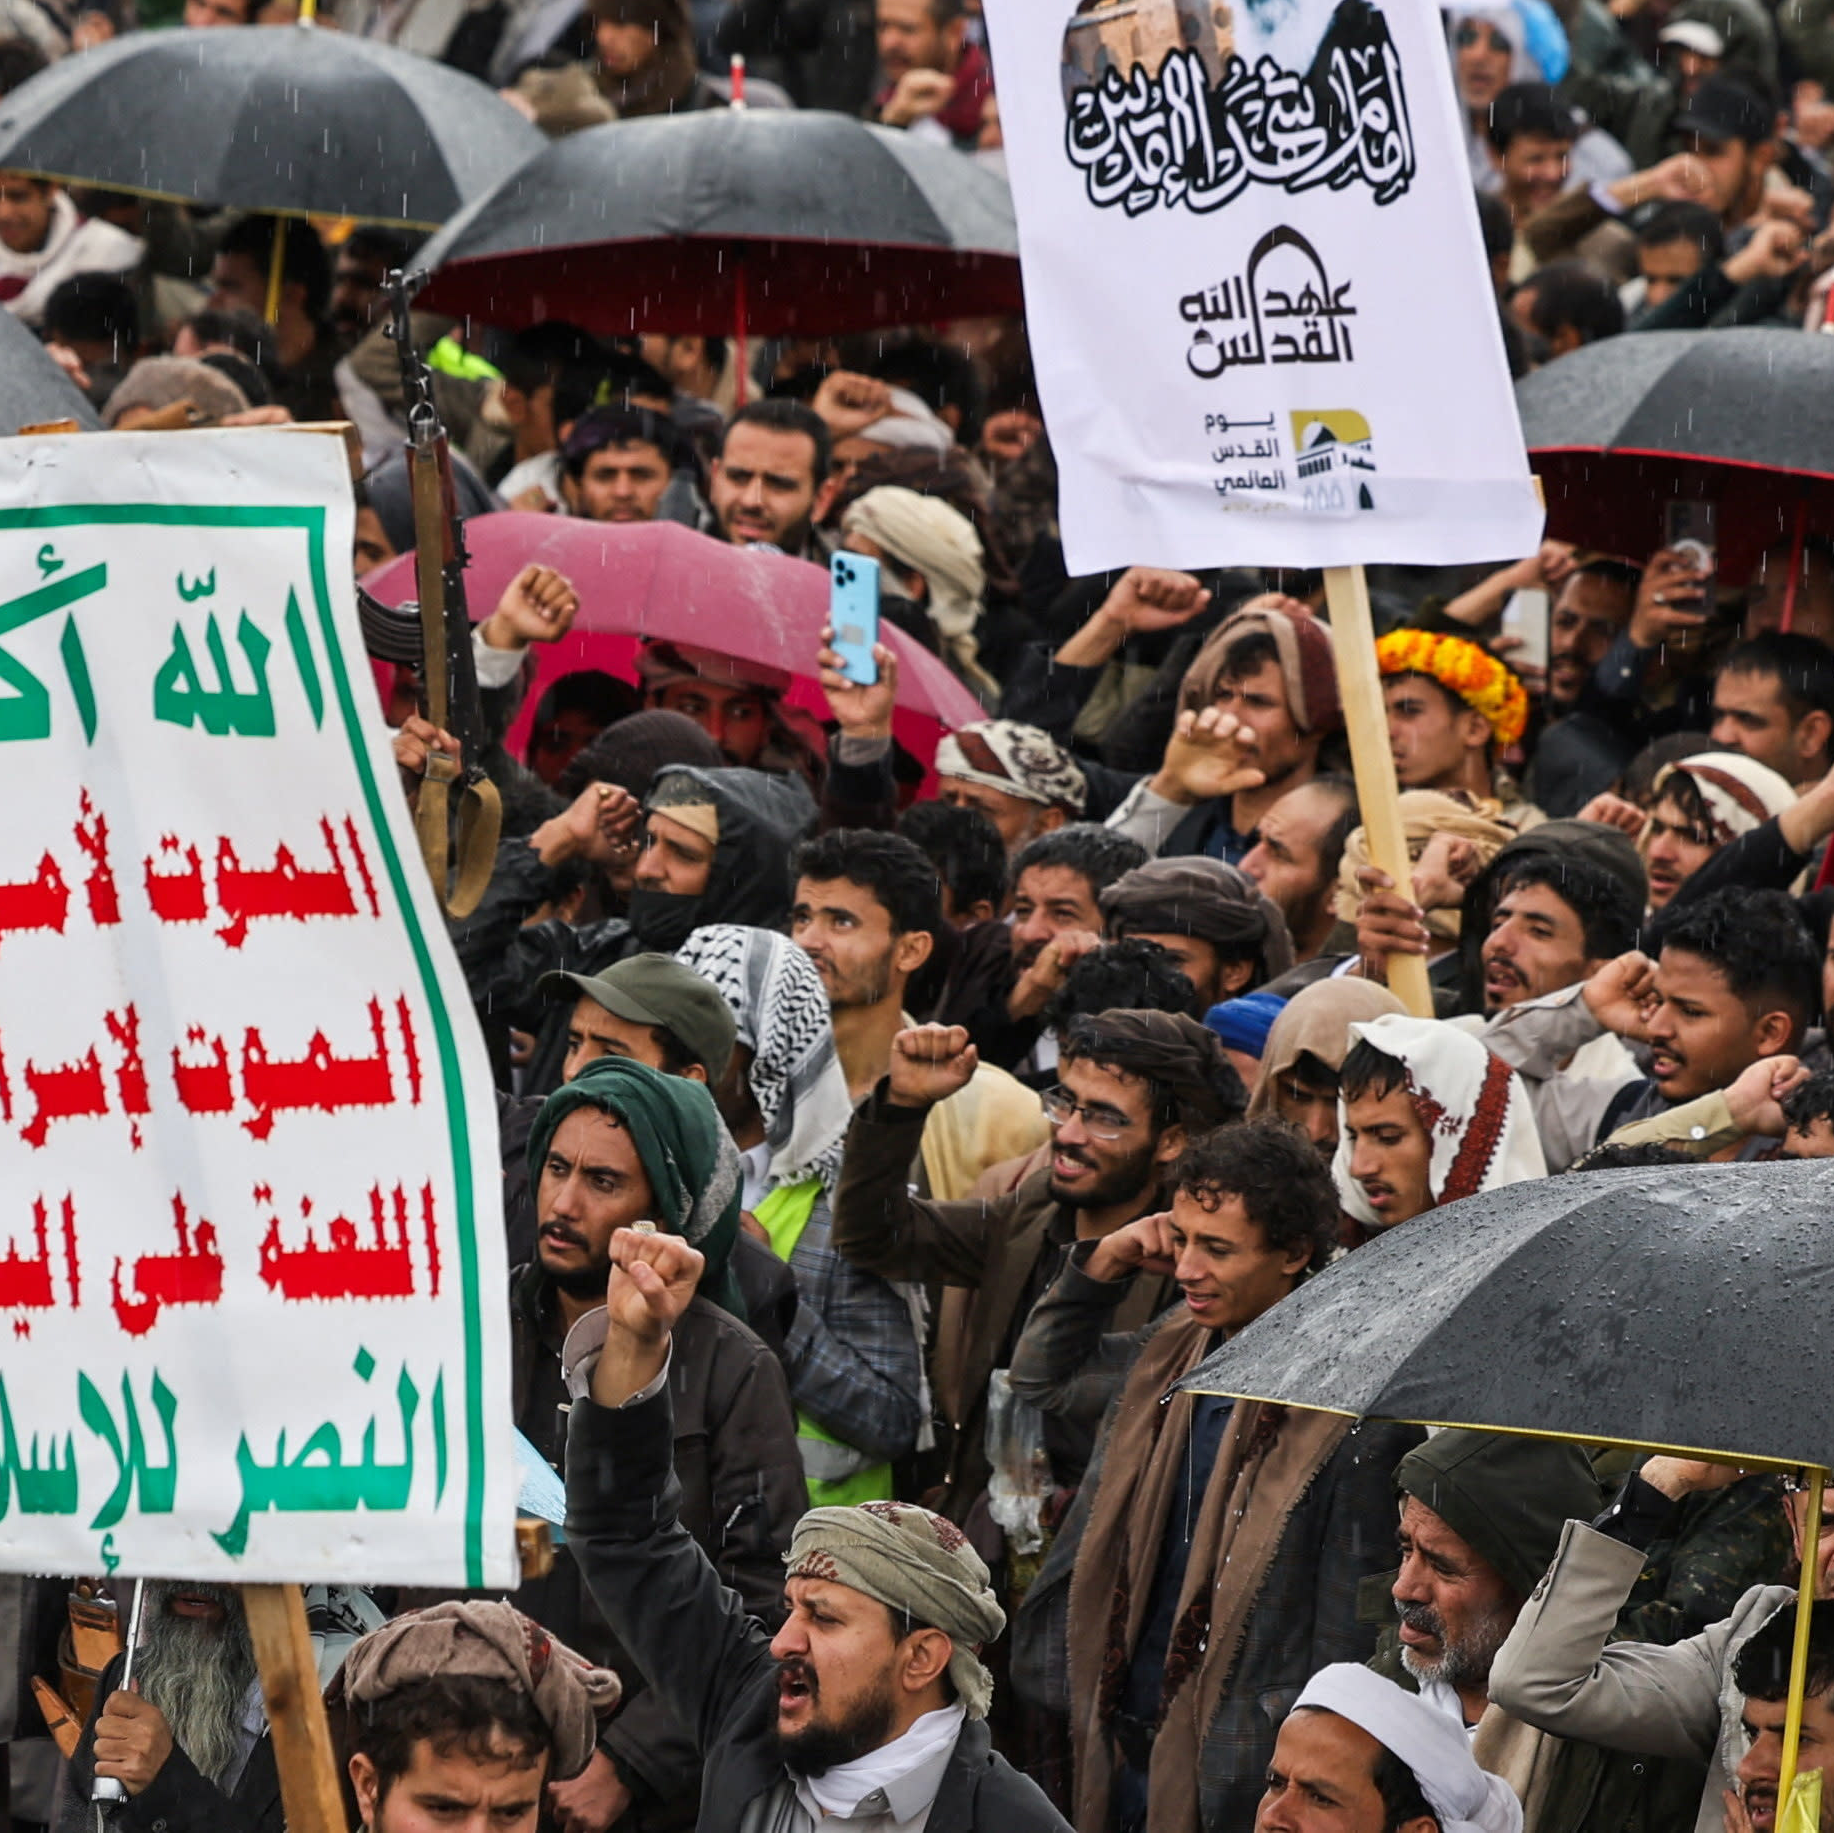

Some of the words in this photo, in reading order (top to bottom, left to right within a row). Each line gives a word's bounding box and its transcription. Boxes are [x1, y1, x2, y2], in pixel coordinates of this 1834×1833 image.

[1179, 275, 1246, 322] الله
[1263, 280, 1357, 316] عهد
[1187, 321, 1354, 379] القدس
[1204, 411, 1274, 432] يوم
[1211, 439, 1279, 463] القدس
[1214, 471, 1285, 497] العالمي
[153, 570, 324, 738] الله
[143, 814, 383, 950] الموت
[170, 992, 425, 1142] الموت
[109, 1191, 227, 1338] على
[252, 1180, 443, 1302] اللعنة
[212, 1346, 448, 1557] النصر
